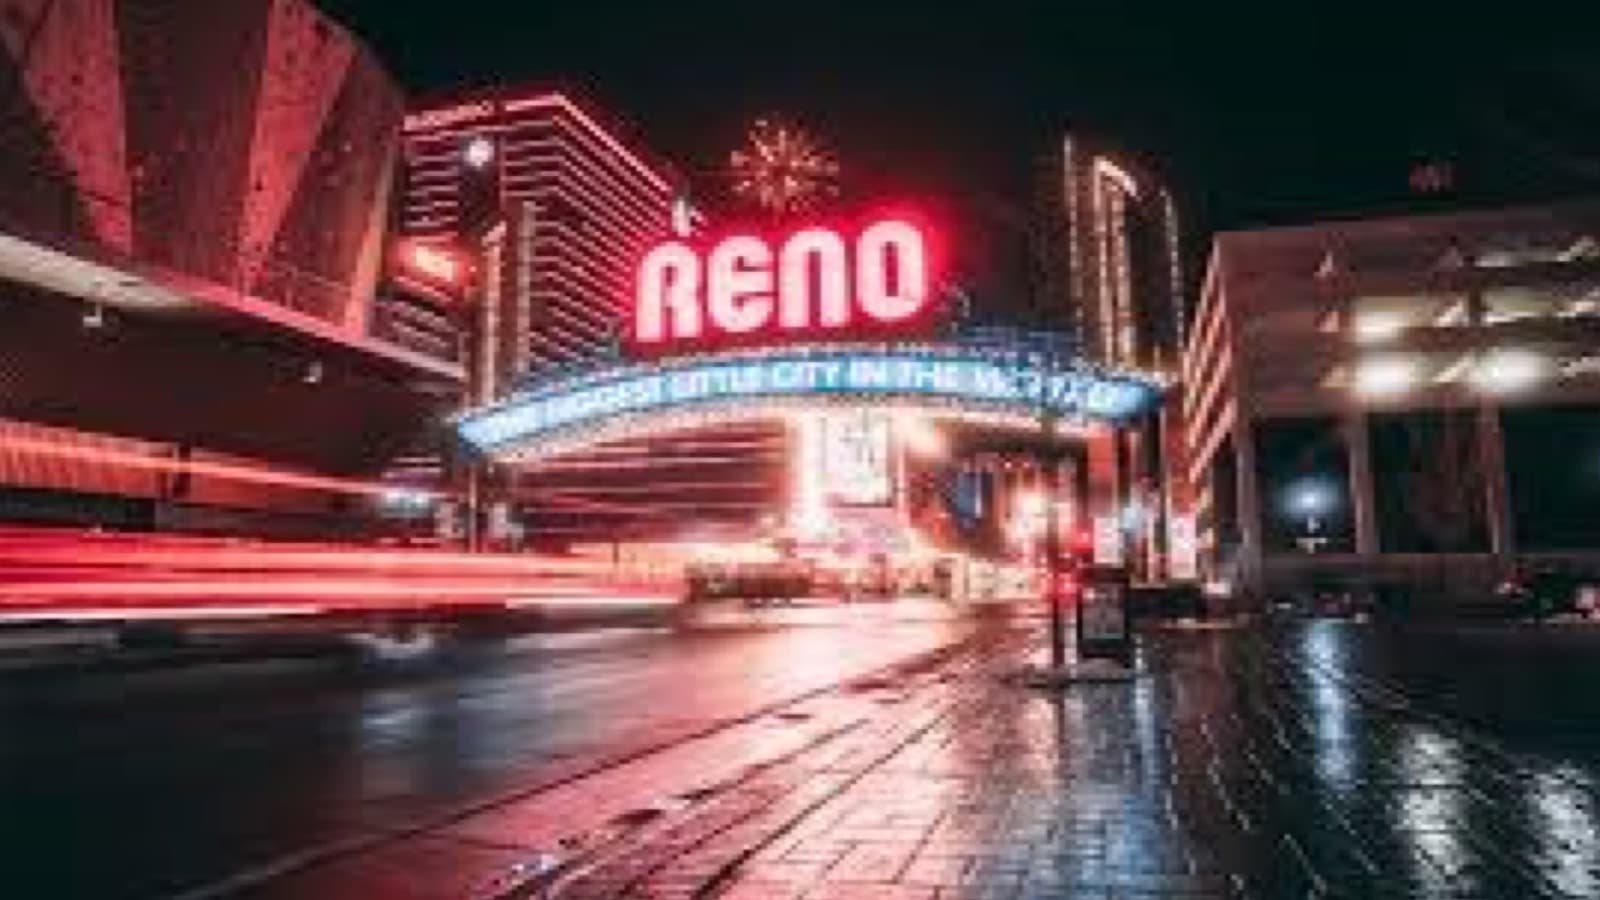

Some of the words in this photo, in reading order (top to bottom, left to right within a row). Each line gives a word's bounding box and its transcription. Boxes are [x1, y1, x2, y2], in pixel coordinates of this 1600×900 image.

[770, 361, 842, 391] CITY
[851, 361, 887, 390] IN
[897, 361, 960, 391] THE
